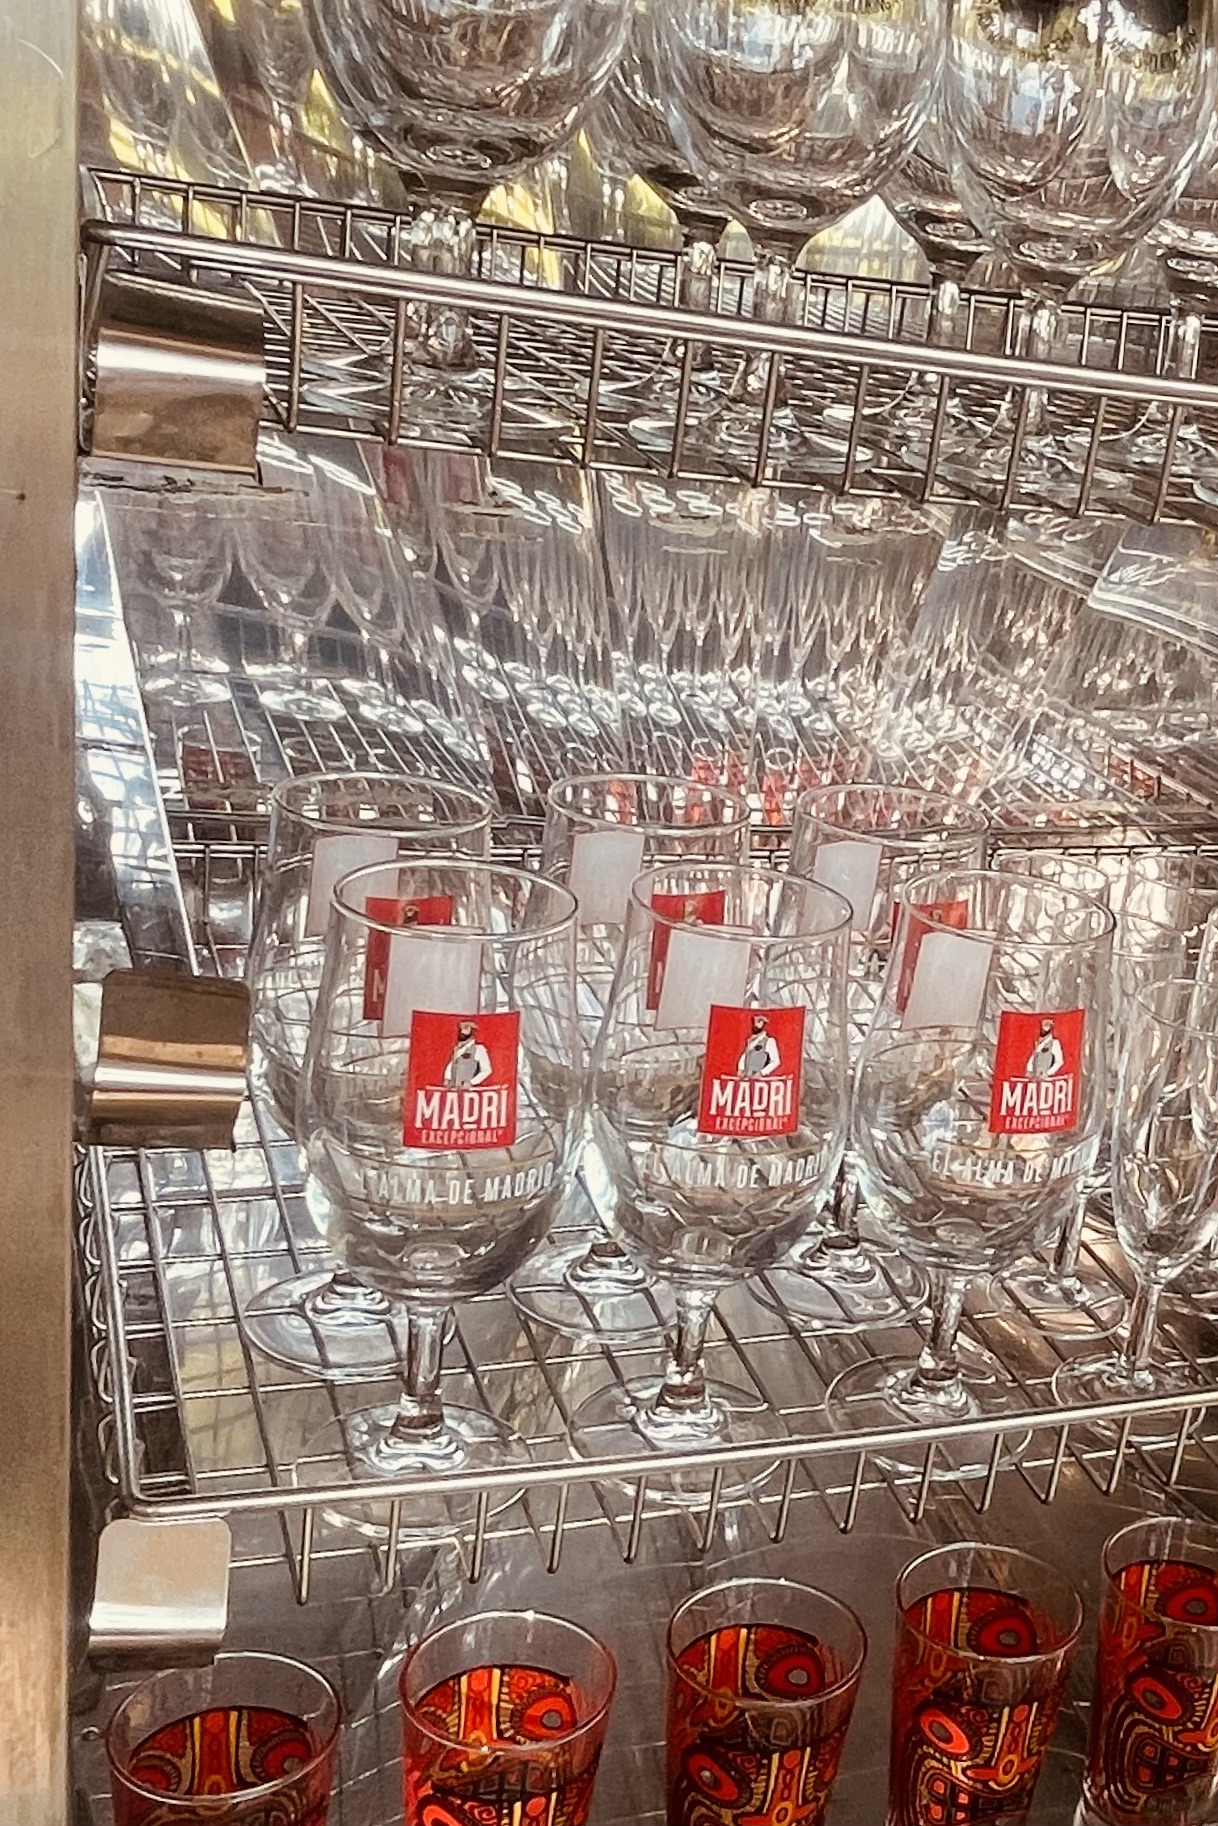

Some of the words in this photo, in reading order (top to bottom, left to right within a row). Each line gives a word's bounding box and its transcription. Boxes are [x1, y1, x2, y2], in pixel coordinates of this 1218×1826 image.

[378, 1174, 436, 1205] ALMA
[449, 1178, 475, 1205] DE
[736, 1163, 760, 1189] DE
